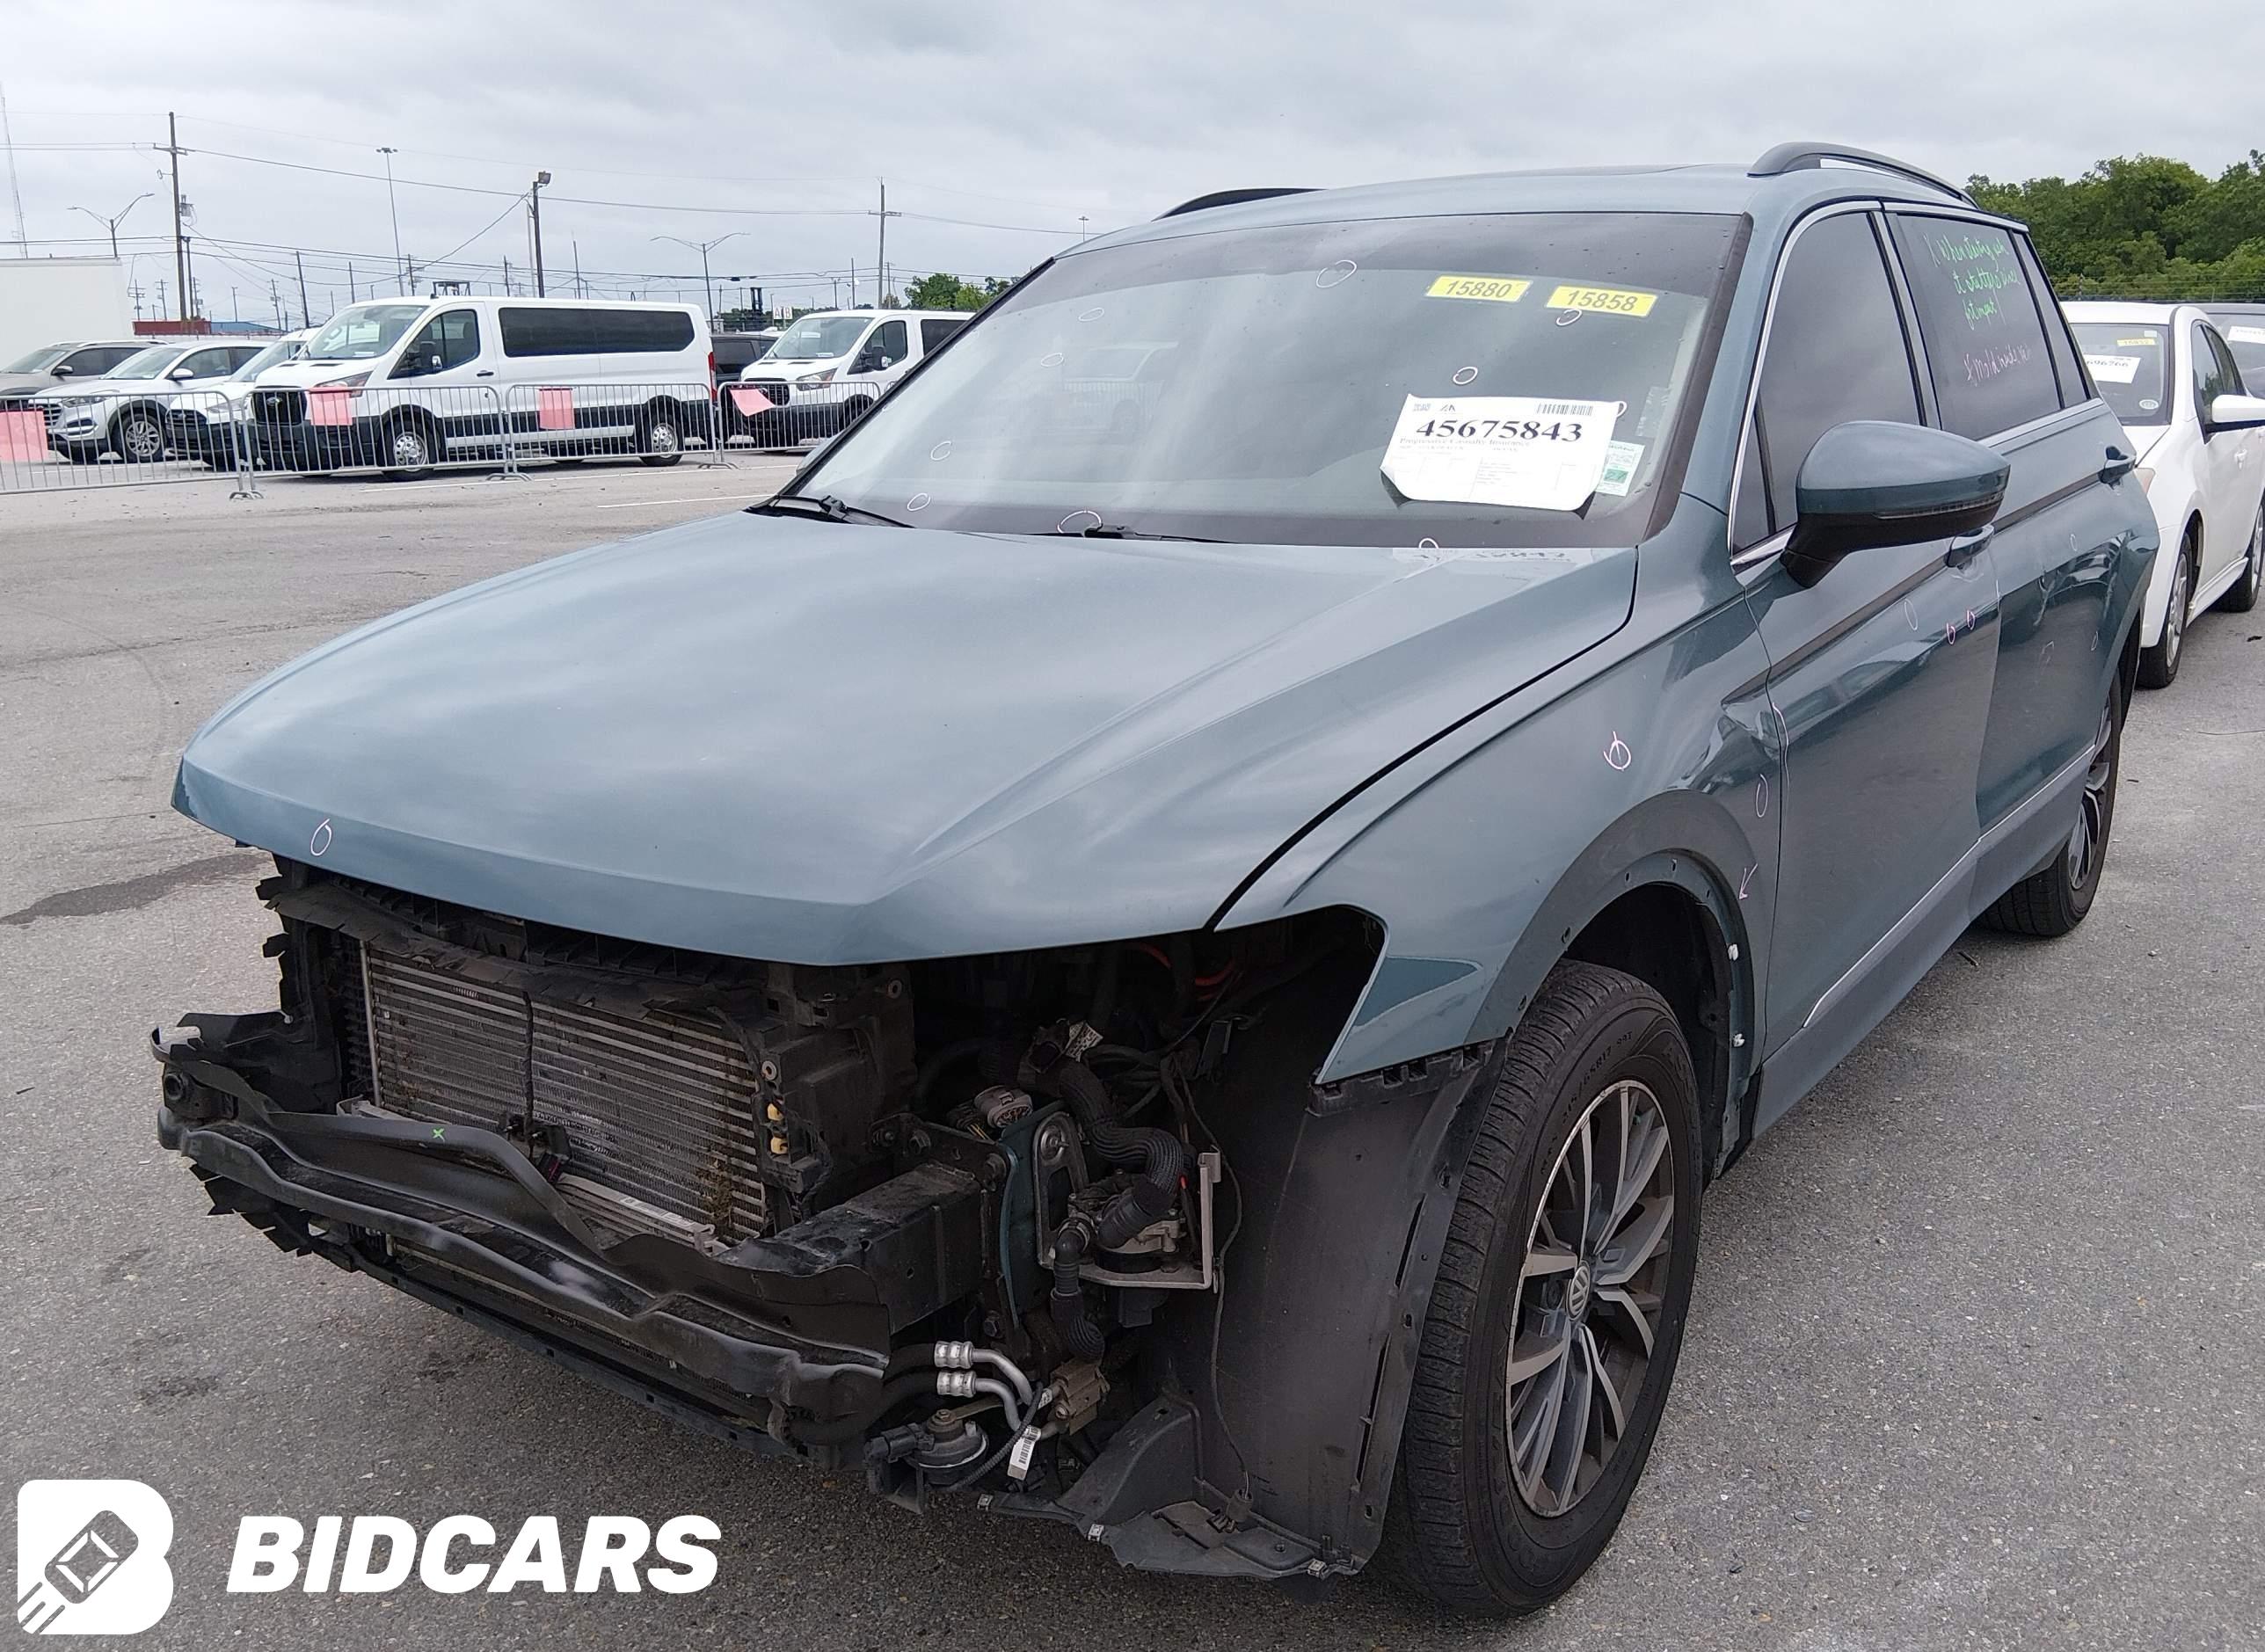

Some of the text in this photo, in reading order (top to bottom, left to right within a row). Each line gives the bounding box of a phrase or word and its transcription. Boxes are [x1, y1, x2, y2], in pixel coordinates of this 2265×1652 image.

[1447, 280, 1511, 298] 15880
[1568, 290, 1638, 312] 15858
[1416, 419, 1582, 442] 45675843
